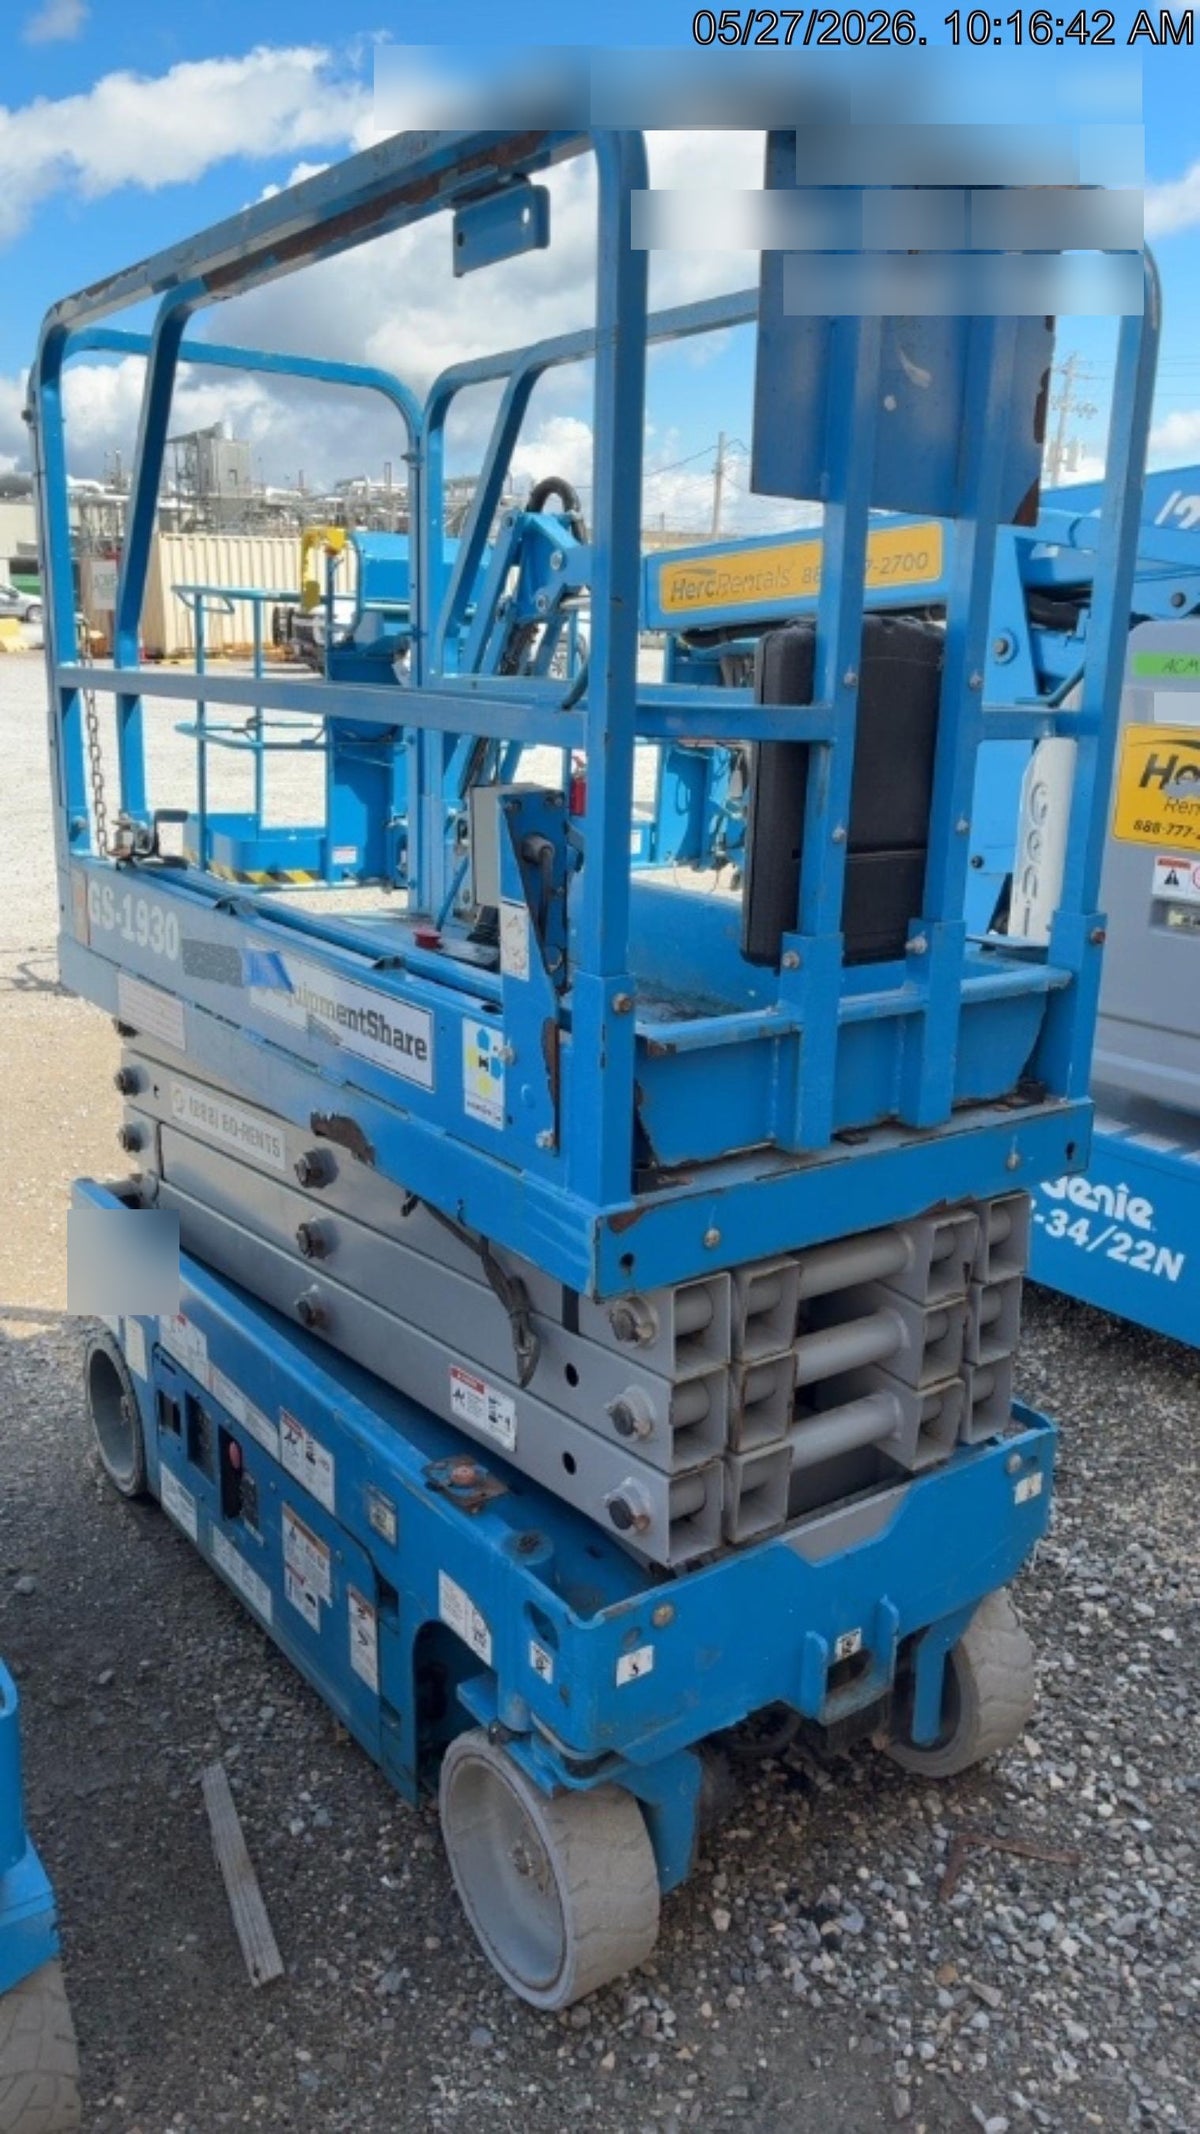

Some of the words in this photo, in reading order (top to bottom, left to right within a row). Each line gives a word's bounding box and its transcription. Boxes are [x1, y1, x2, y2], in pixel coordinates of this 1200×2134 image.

[1133, 819, 1200, 841] 888-777-
[88, 880, 180, 961] GS-1930
[1030, 1198, 1186, 1283] -34/22N
